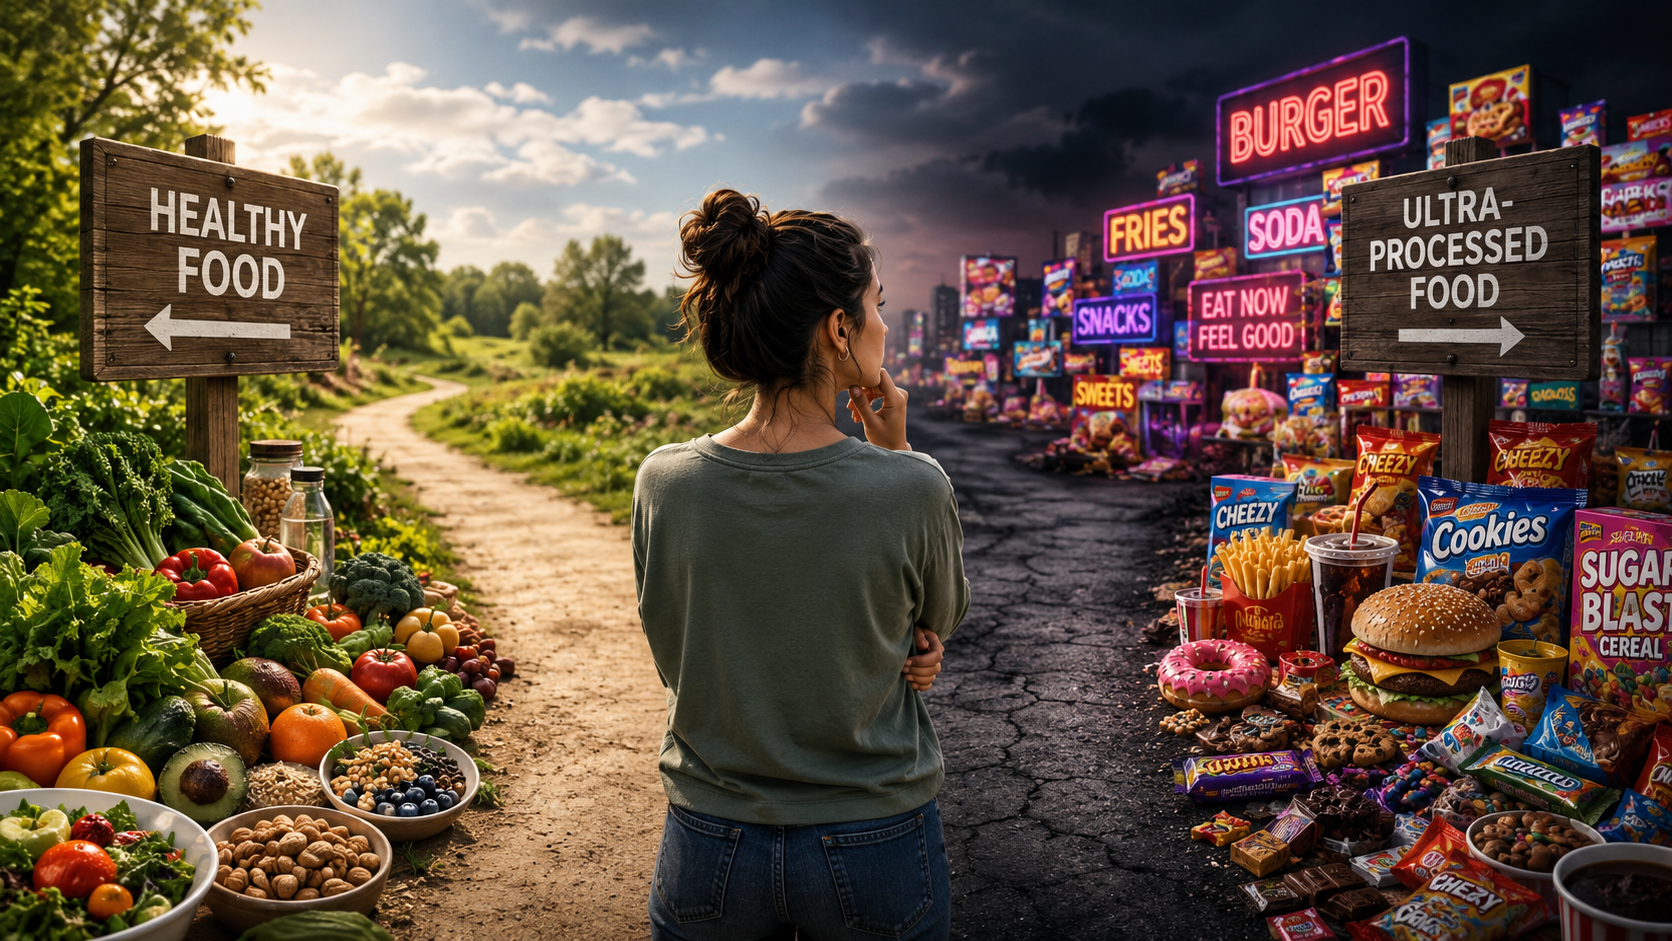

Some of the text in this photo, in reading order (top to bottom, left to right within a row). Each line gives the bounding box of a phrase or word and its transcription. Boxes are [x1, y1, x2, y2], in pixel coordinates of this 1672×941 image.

[1229, 70, 1390, 164] BURGER
[150, 187, 307, 250] HEALTHY
[1247, 203, 1324, 251] SODA
[1403, 187, 1513, 229] ULTRA-
[1109, 204, 1188, 254] FRIES
[1369, 225, 1549, 272] PROCESSED
[178, 246, 285, 300] FOOD
[1410, 273, 1500, 310] FOOD
[1078, 302, 1152, 336] SNACKS
[1201, 285, 1289, 319] EAT NOW
[1198, 321, 1294, 350] FEEL GOOD
[1075, 381, 1135, 409] SWEETS
[1358, 453, 1418, 479] CHEEZY
[1216, 502, 1279, 529] CHEEZY
[1431, 511, 1548, 560] Cookies
[1599, 636, 1663, 659] CEREAL
